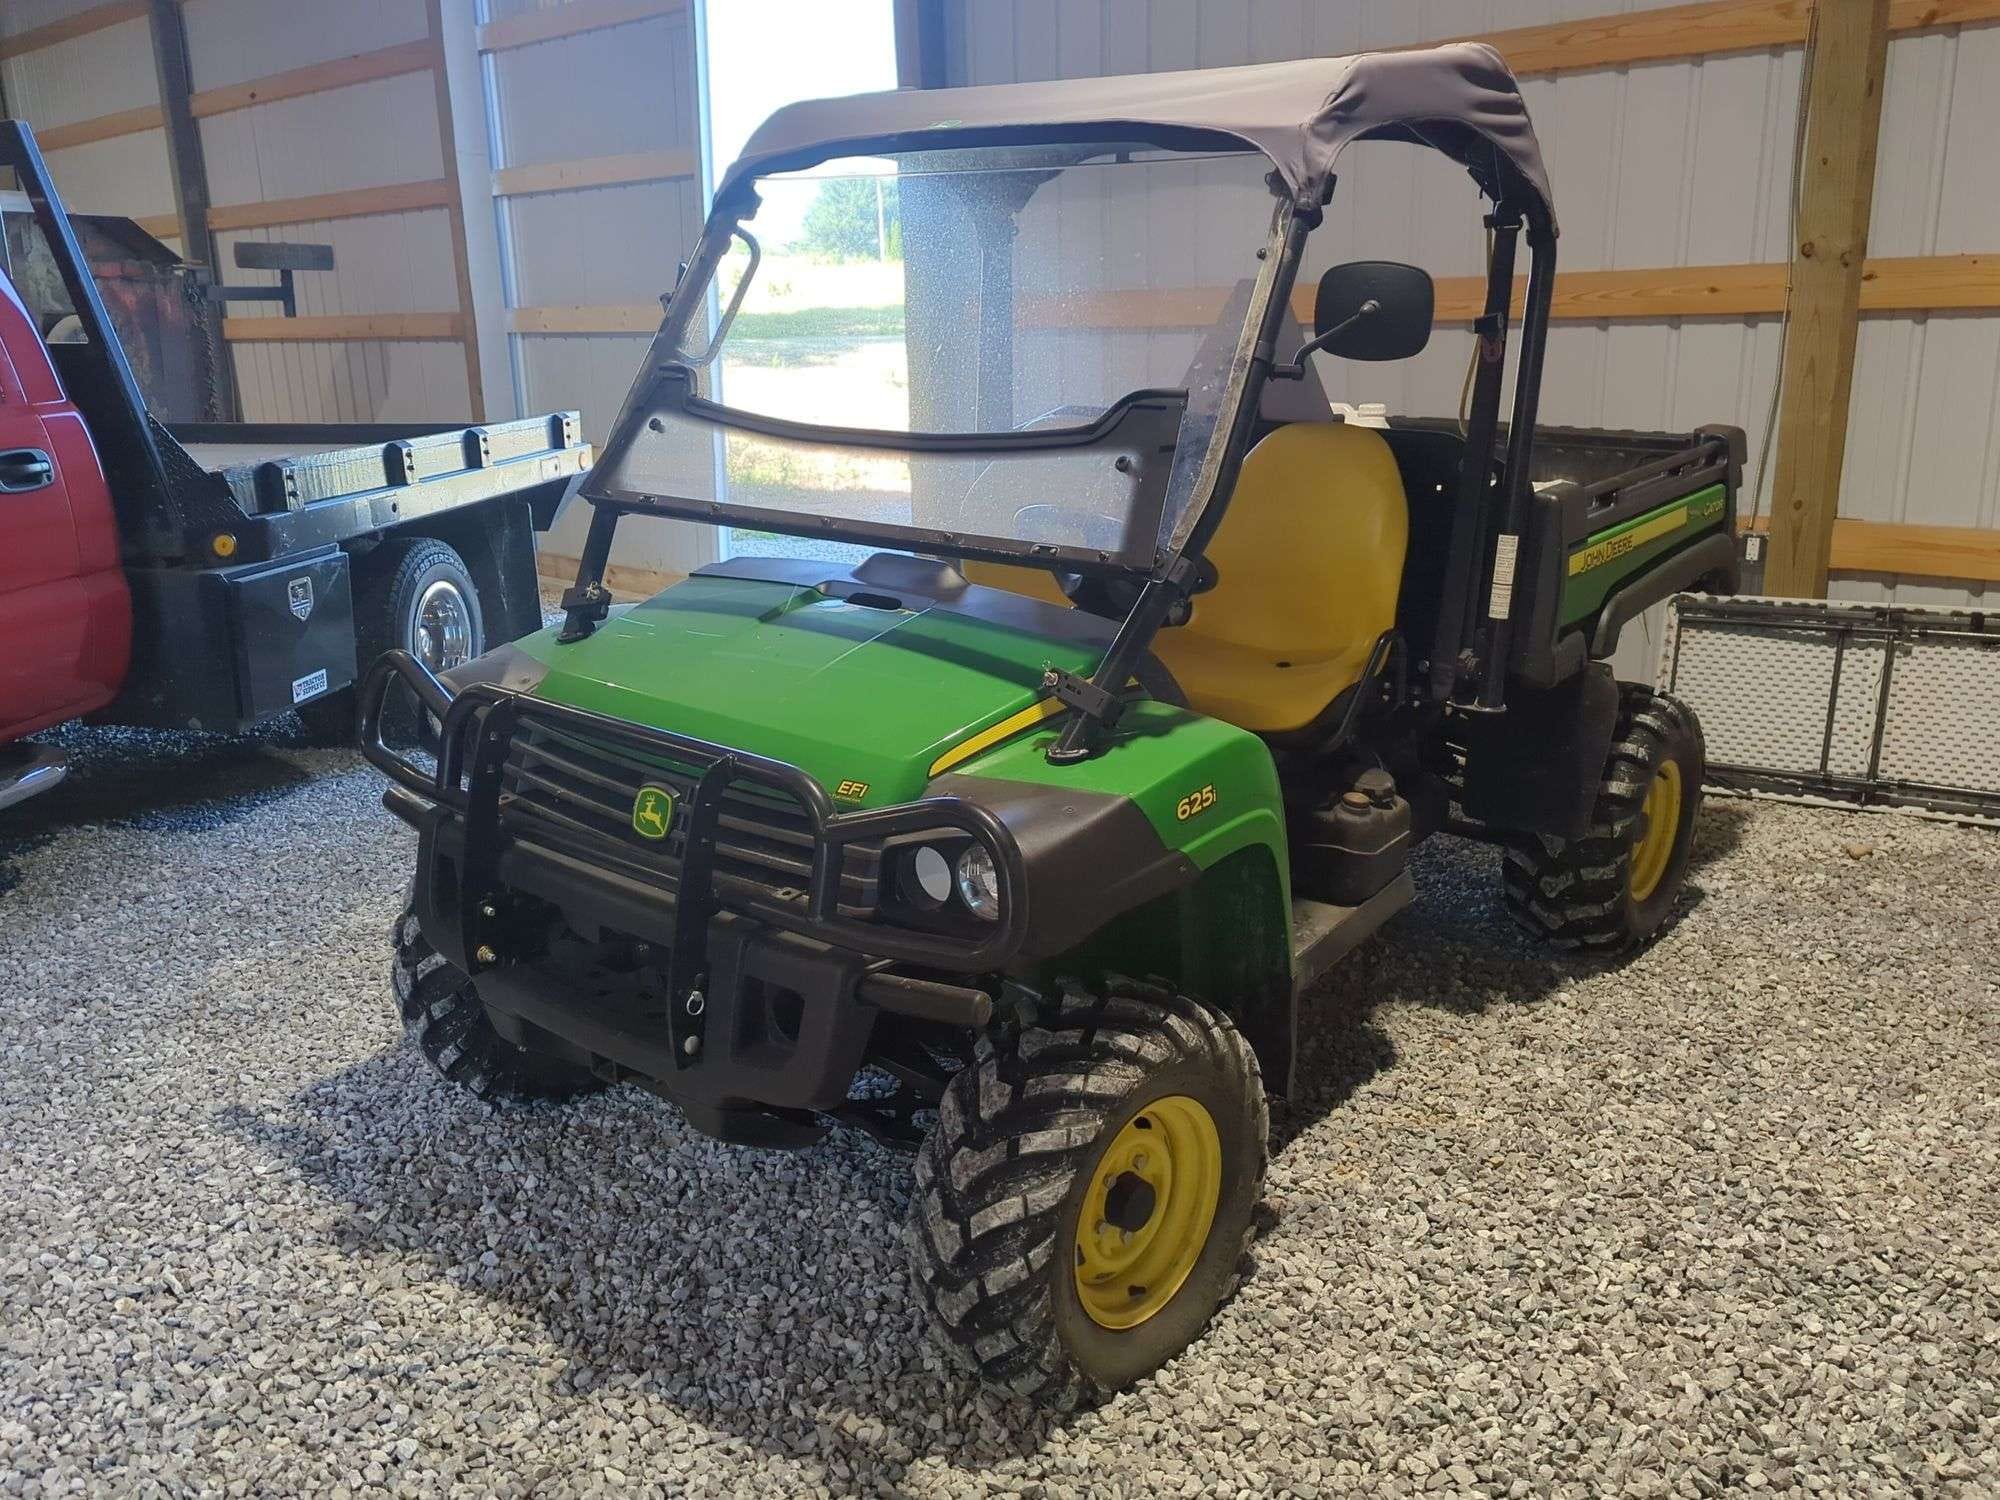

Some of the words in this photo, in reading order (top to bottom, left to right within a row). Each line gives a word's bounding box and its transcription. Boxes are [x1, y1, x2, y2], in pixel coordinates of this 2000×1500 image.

[1581, 547, 1604, 571] JOHN
[1605, 535, 1634, 559] DEERE
[302, 673, 325, 689] TRACTOR
[302, 683, 320, 696] SUPPLY
[837, 780, 869, 798] EFI
[1177, 784, 1217, 820] 625i
